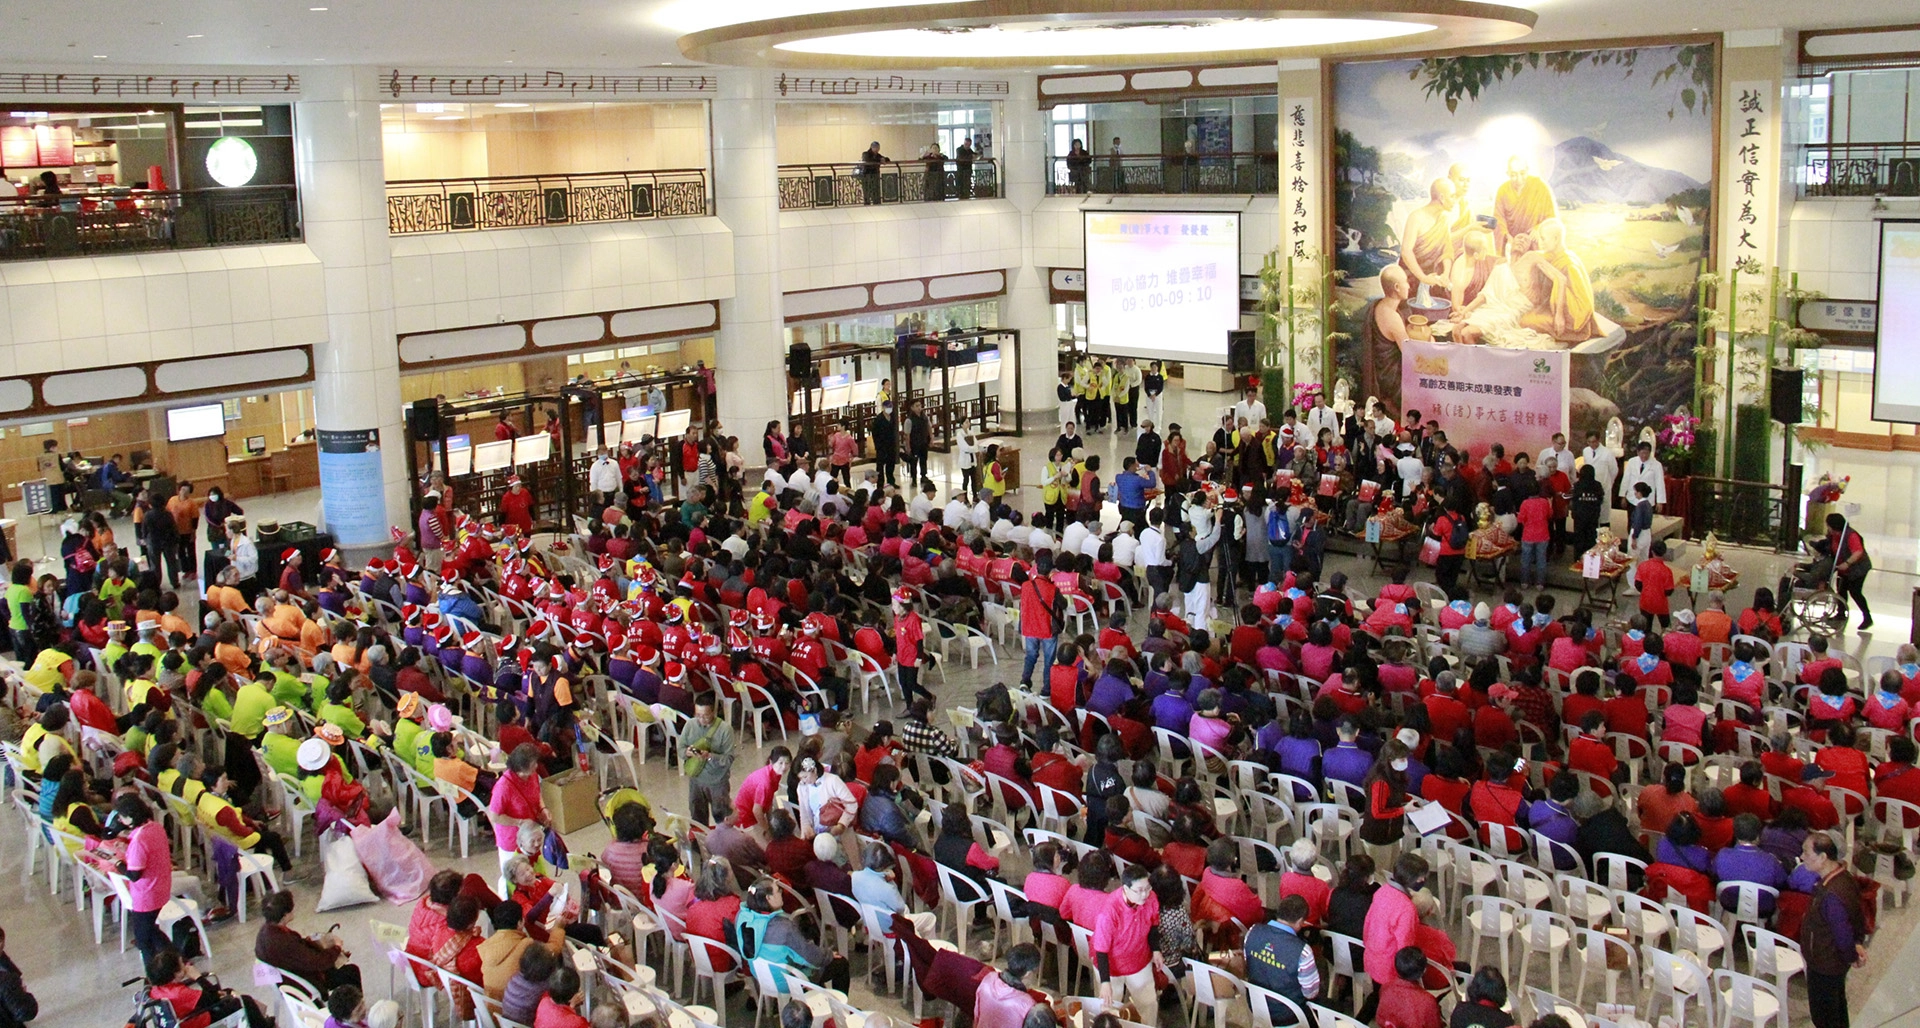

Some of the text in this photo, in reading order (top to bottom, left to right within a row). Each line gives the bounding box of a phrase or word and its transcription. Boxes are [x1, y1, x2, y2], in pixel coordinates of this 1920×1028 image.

[1112, 272, 1159, 294] 同心協力
[1418, 378, 1523, 398] 高齡友善期末成果發表會
